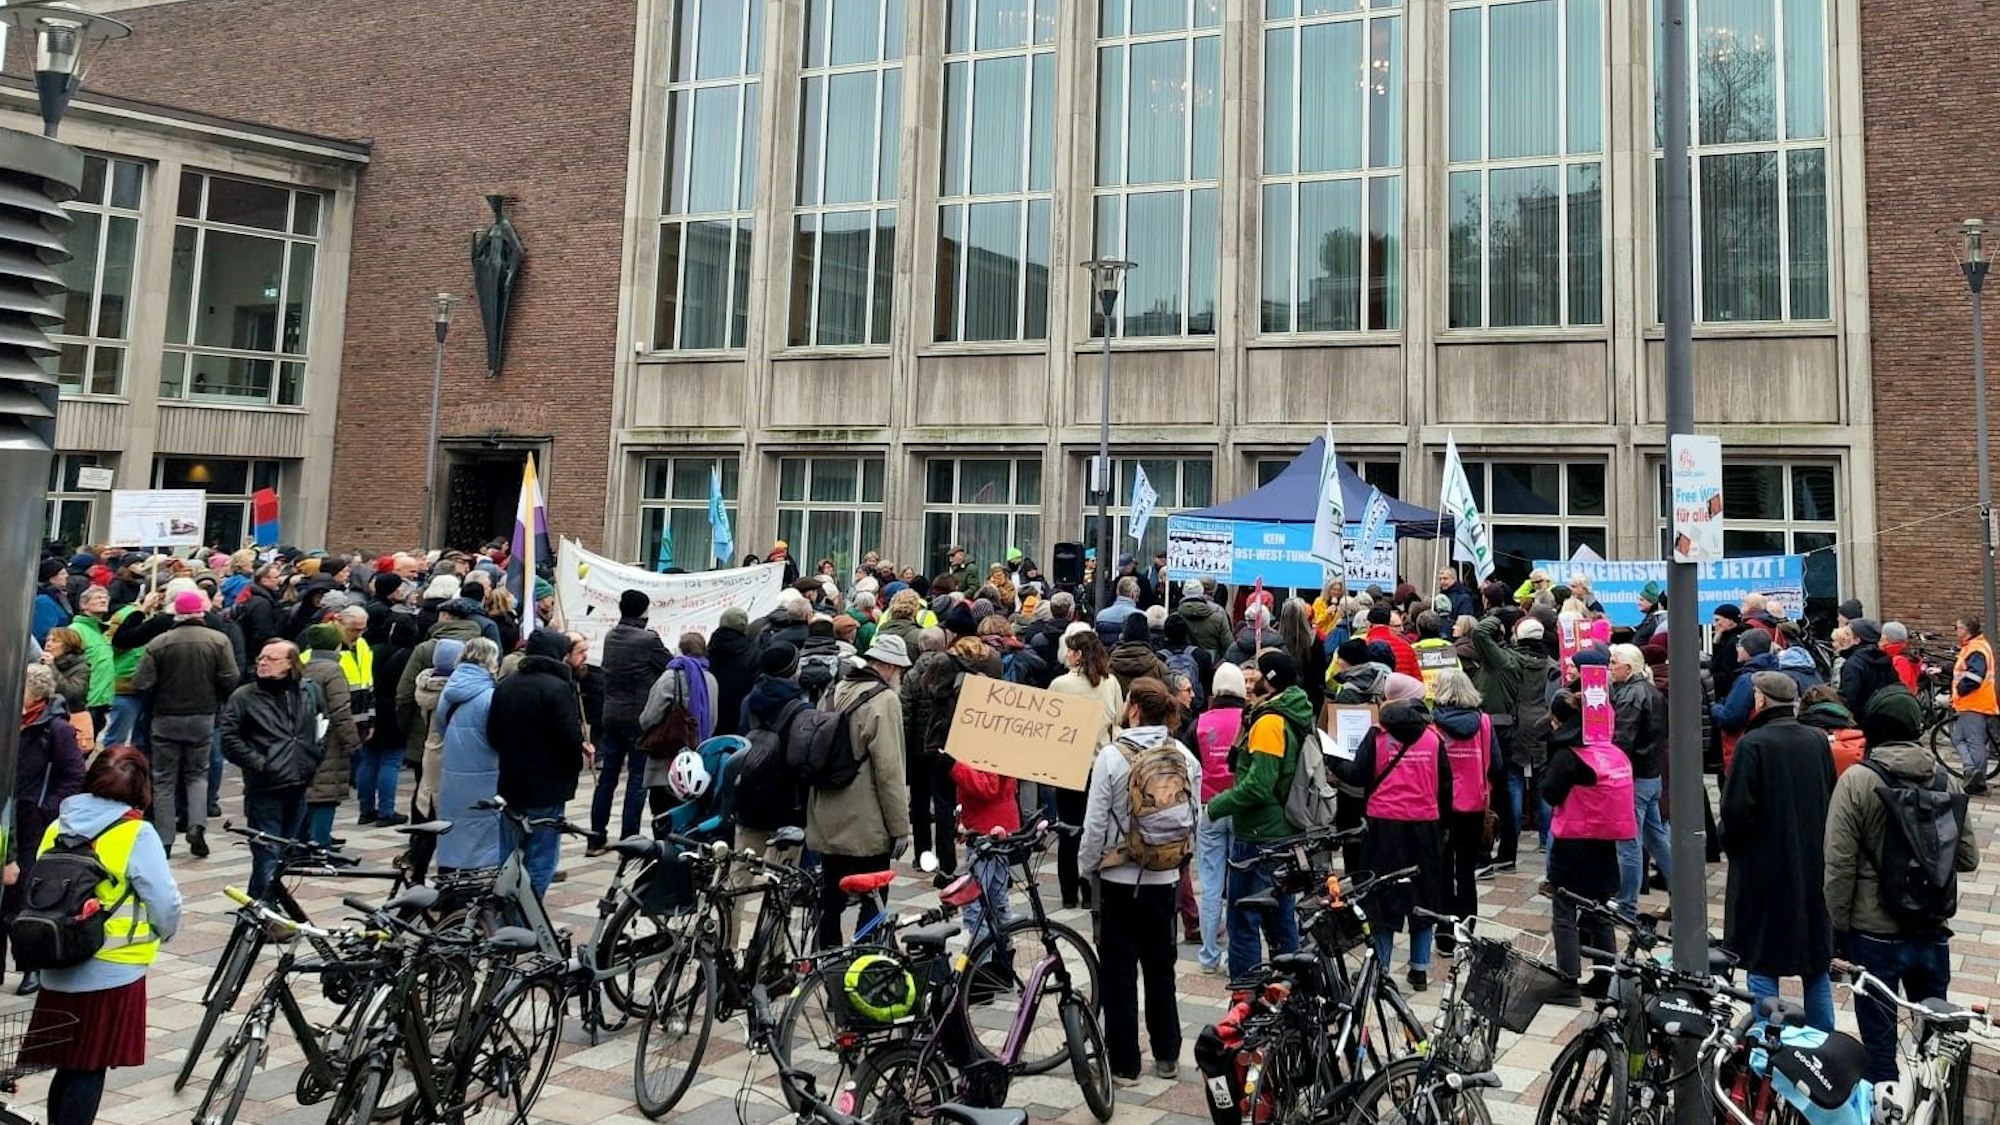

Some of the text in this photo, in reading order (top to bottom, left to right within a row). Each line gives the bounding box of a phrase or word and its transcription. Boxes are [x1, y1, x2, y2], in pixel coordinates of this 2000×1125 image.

[1675, 487, 1697, 503] Free
[1677, 508, 1690, 522] für
[1263, 533, 1286, 545] KEIN
[1545, 560, 1716, 582] VERKEHRSWDE
[1721, 560, 1771, 580] JETZT
[986, 683, 1065, 718] KÖLNS
[960, 708, 1078, 745] STUTTGART 21
[1659, 1001, 1704, 1016] DOORDASH
[1793, 1050, 1834, 1091] DOORDASH
